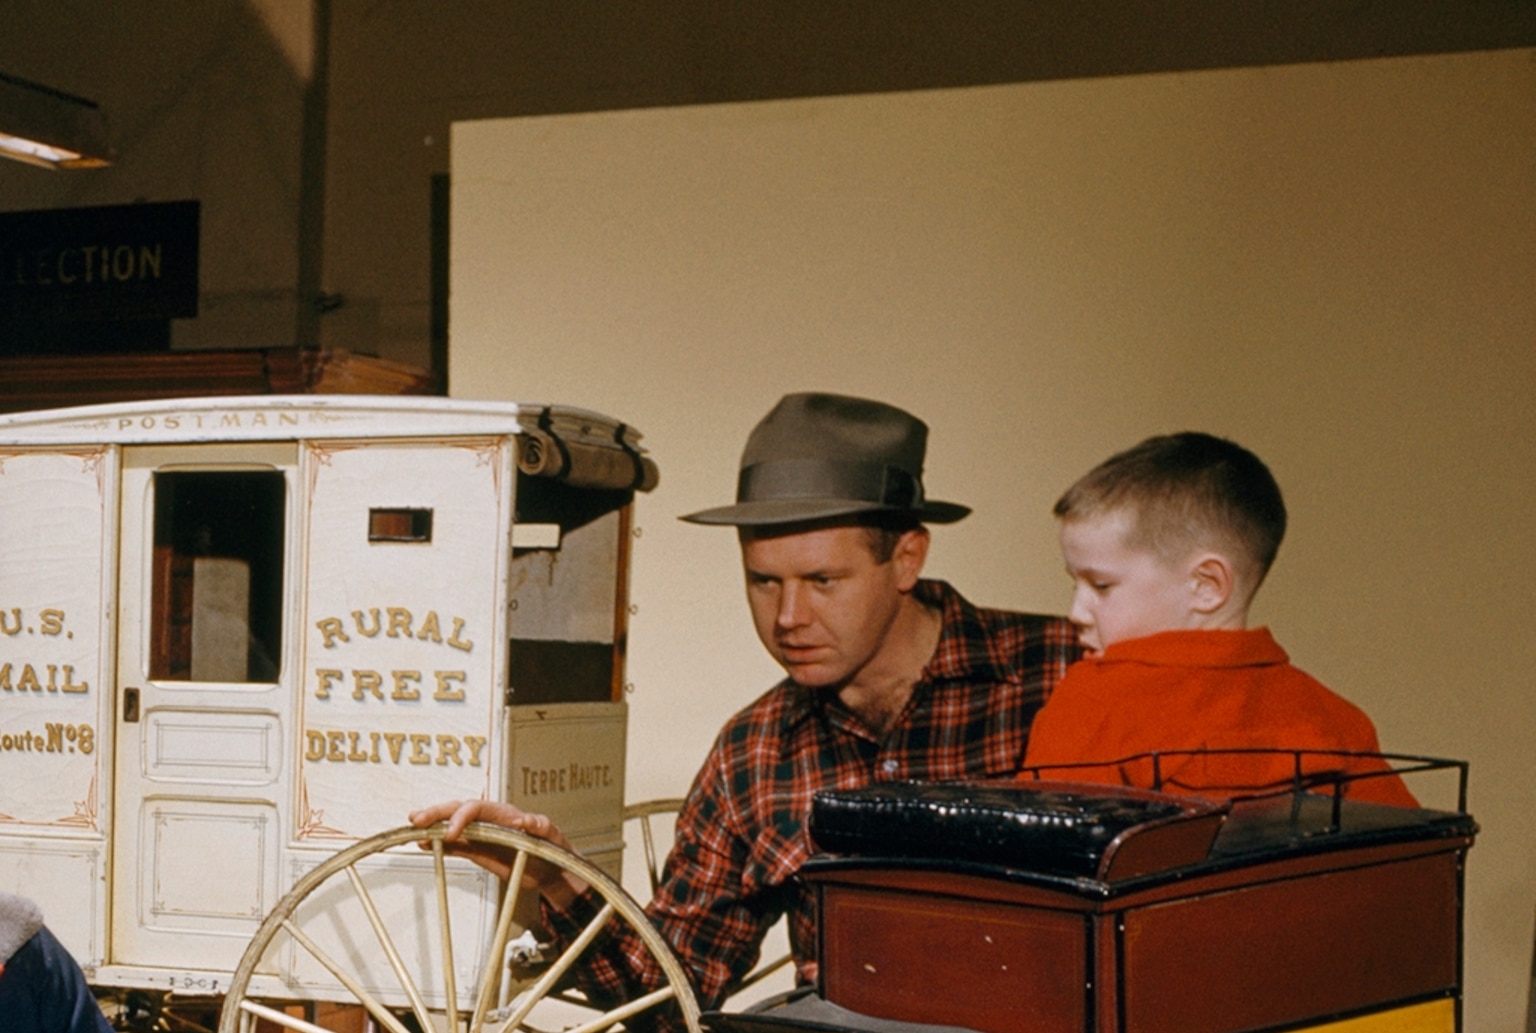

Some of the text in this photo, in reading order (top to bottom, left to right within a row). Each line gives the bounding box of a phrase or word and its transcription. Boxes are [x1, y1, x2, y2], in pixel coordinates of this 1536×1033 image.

[315, 606, 474, 653] RURAL
[314, 668, 467, 702] FREE
[305, 729, 487, 767] DELIVERY
[521, 765, 566, 796] TERRE
